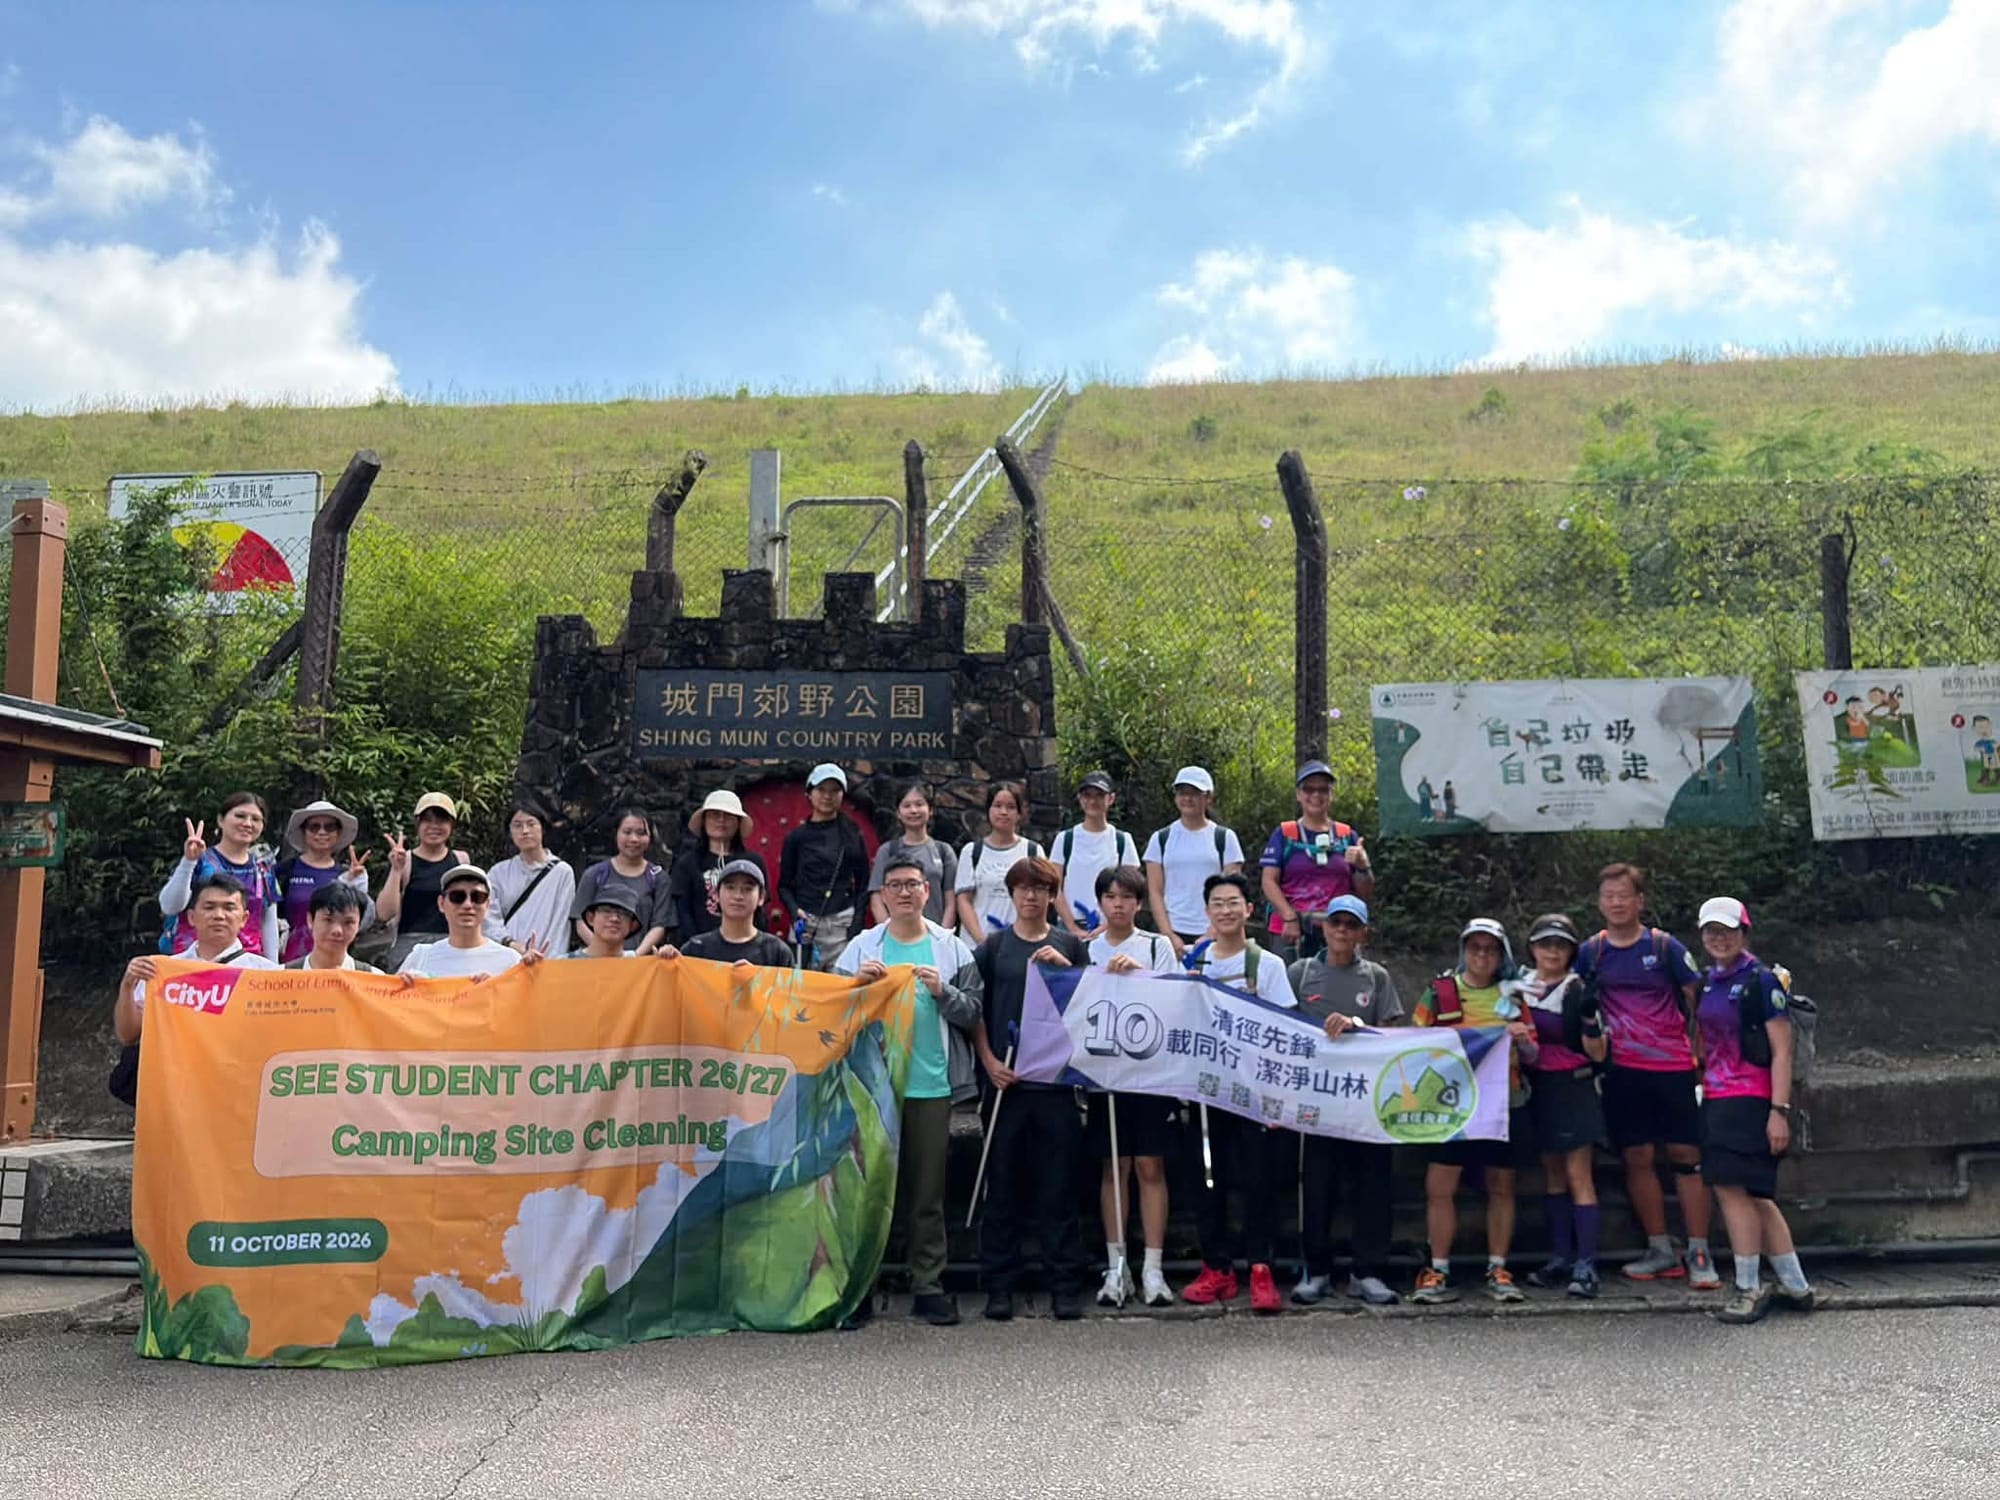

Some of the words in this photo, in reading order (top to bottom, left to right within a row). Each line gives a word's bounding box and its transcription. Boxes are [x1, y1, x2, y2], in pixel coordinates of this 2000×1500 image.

[661, 681, 925, 719] 城門郊野公園
[639, 729, 712, 746] SHING
[720, 730, 768, 746] MUN
[776, 730, 882, 748] COUNTRY
[890, 731, 946, 748] PARK
[1486, 715, 1637, 748] 自己垃圾
[1499, 751, 1651, 785] 自己帶走
[164, 982, 232, 1011] CityU
[248, 978, 293, 991] School
[297, 977, 310, 990] of
[1084, 999, 1164, 1060] 10
[1166, 1027, 1242, 1070] 載同行
[1255, 1055, 1370, 1100] 潔淨山林
[1211, 1005, 1318, 1060] 清徑先鋒
[269, 1063, 339, 1097] SEE
[345, 1063, 523, 1096] STUDENT
[529, 1058, 694, 1096] CHAPTER
[699, 1058, 788, 1096] 26/27
[331, 1123, 498, 1166] Camping
[503, 1123, 575, 1156] Site
[582, 1114, 728, 1153] Cleaning
[208, 1235, 224, 1252] 11
[230, 1232, 322, 1253] OCTOBER
[325, 1232, 372, 1250] 2026
